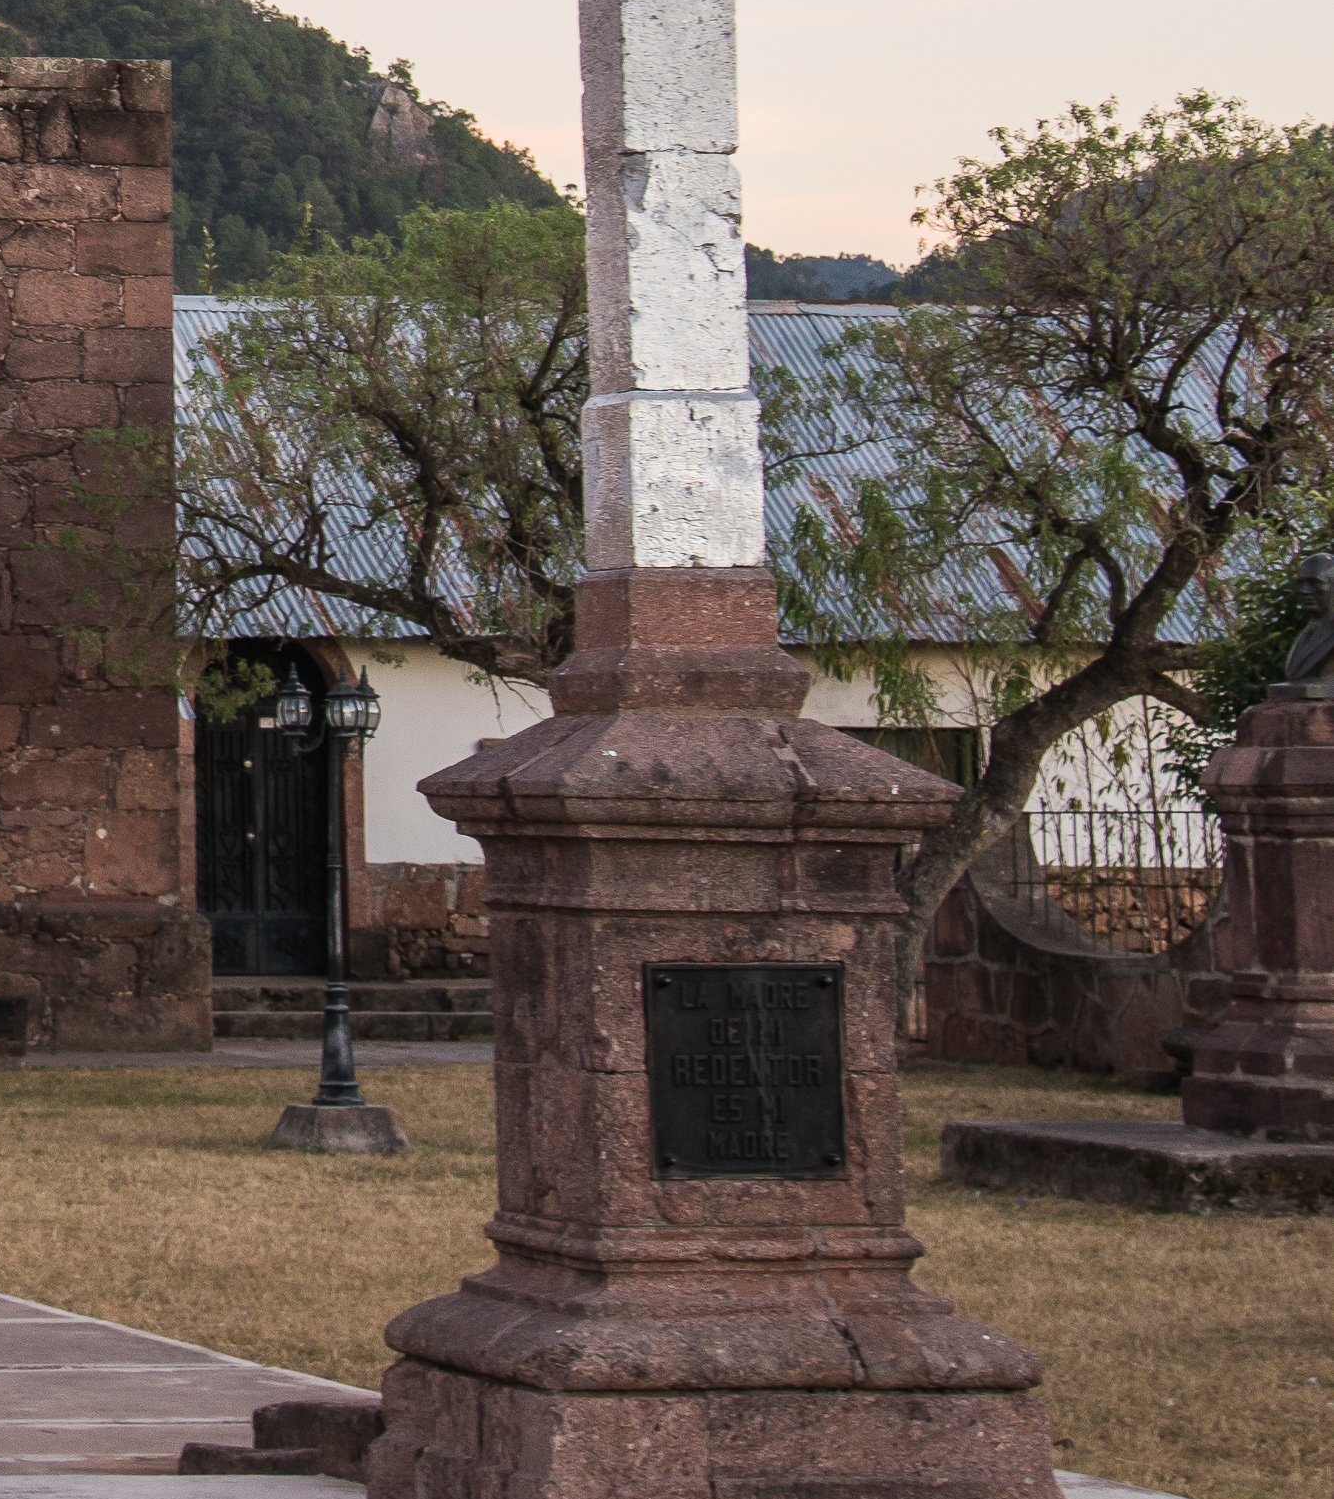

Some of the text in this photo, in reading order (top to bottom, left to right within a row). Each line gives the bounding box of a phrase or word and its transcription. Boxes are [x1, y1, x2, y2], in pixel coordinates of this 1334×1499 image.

[679, 981, 811, 1010] LA MADRE
[708, 1016, 783, 1047] DE MI
[672, 1053, 823, 1087] REDENTOR
[712, 1094, 785, 1123] ES MI
[707, 1130, 791, 1160] MADRE
